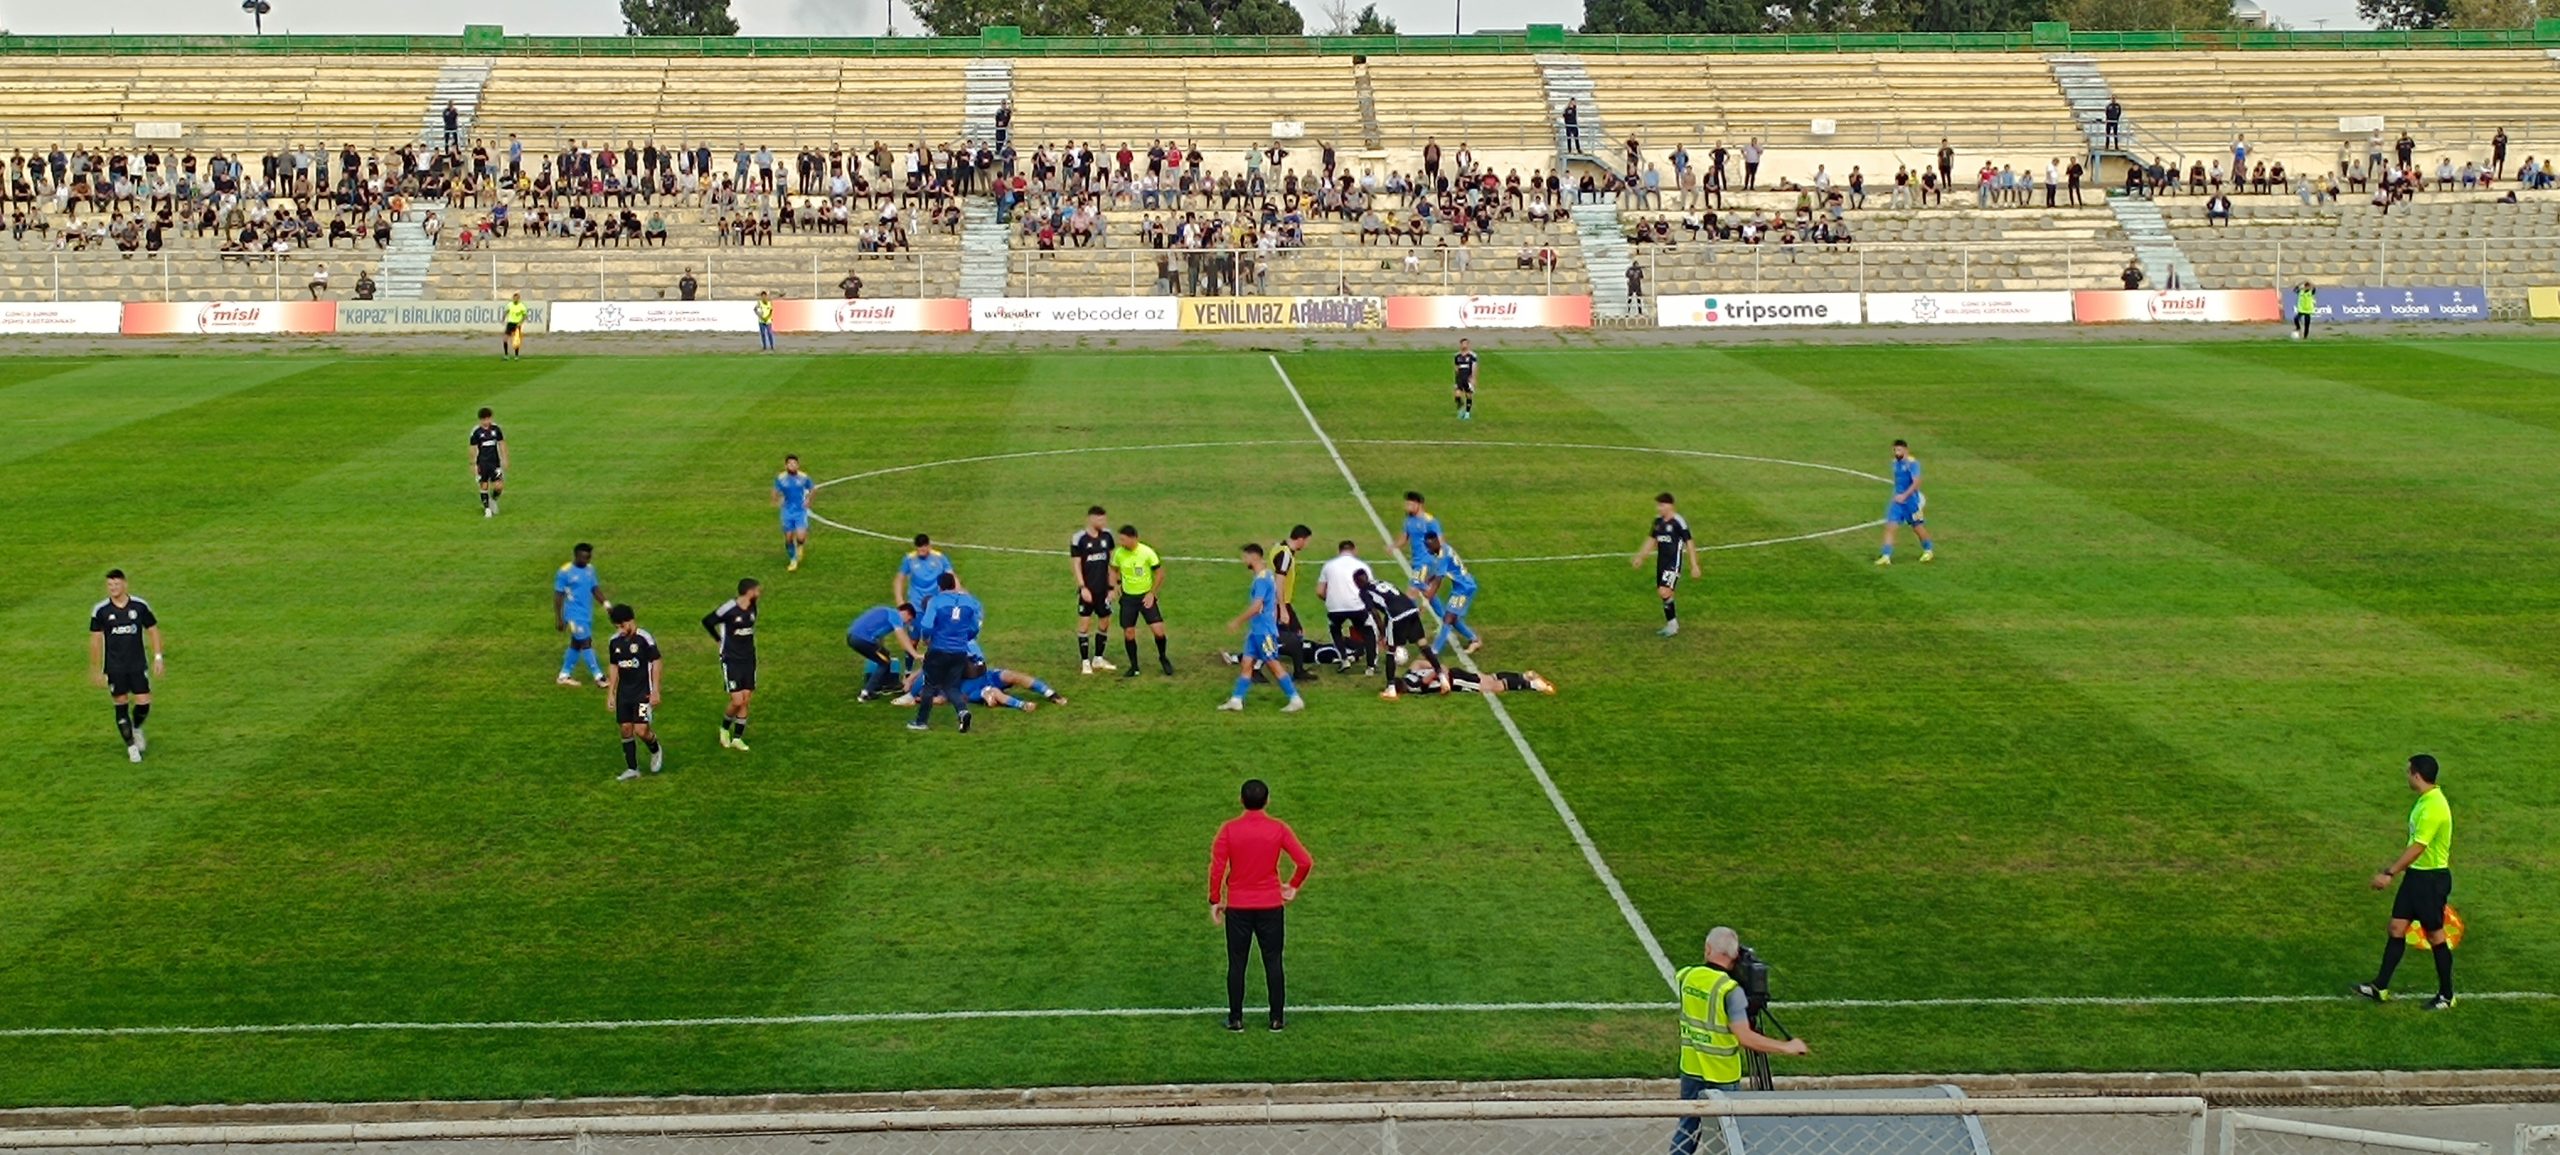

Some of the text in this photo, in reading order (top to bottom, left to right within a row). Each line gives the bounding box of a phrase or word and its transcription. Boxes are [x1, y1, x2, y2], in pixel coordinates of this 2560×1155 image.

[1473, 302, 1518, 315] misli
[2161, 297, 2206, 309] misli
[213, 308, 260, 320] misli
[850, 306, 895, 318] misli
[1725, 300, 1828, 322] tripsome
